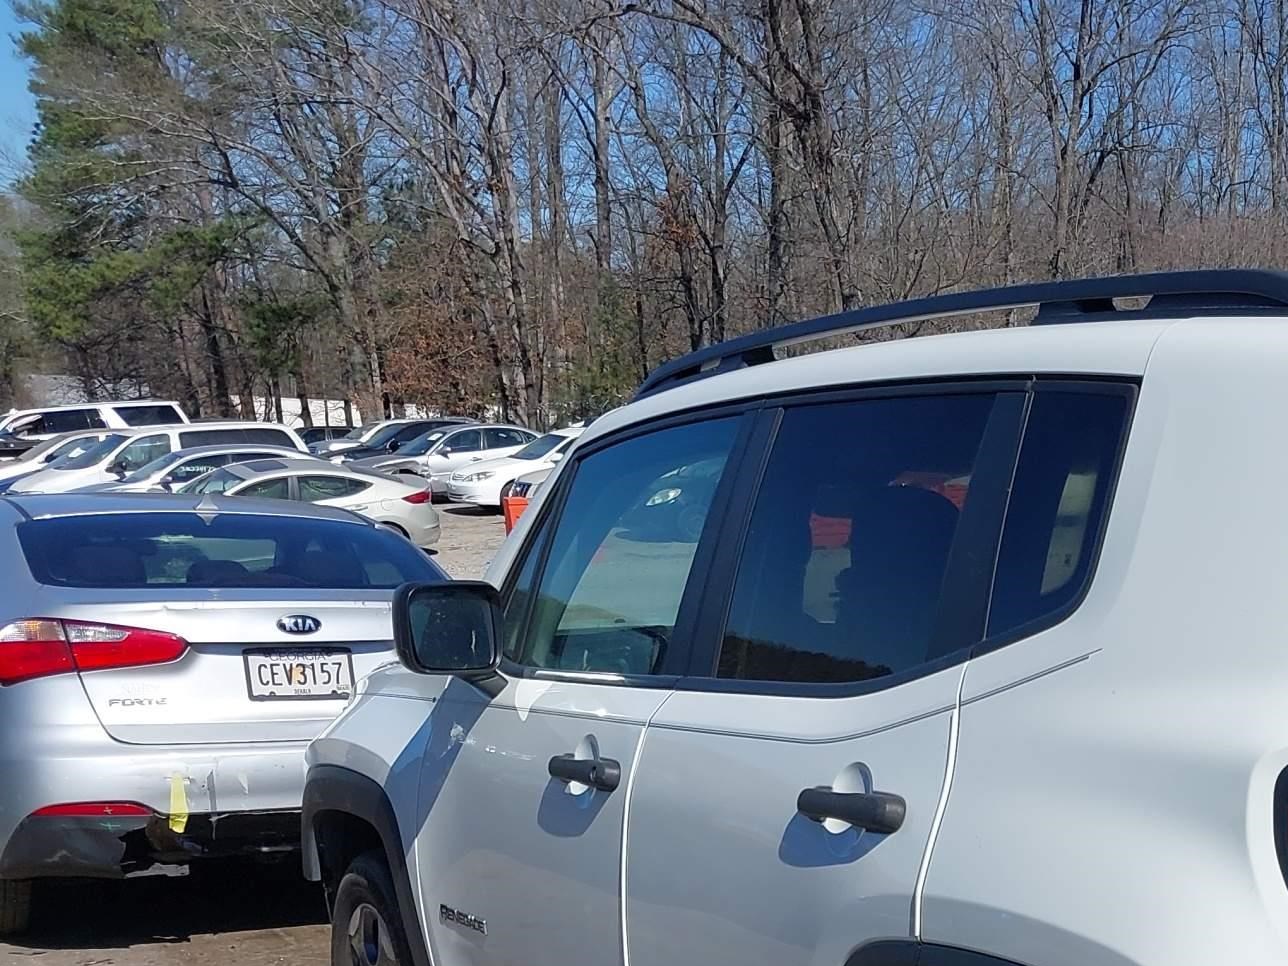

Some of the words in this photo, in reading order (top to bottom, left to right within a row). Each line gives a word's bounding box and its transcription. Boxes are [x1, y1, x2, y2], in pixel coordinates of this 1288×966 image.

[282, 617, 316, 631] KIA
[257, 662, 343, 687] CEV3157
[108, 697, 168, 707] FORTE
